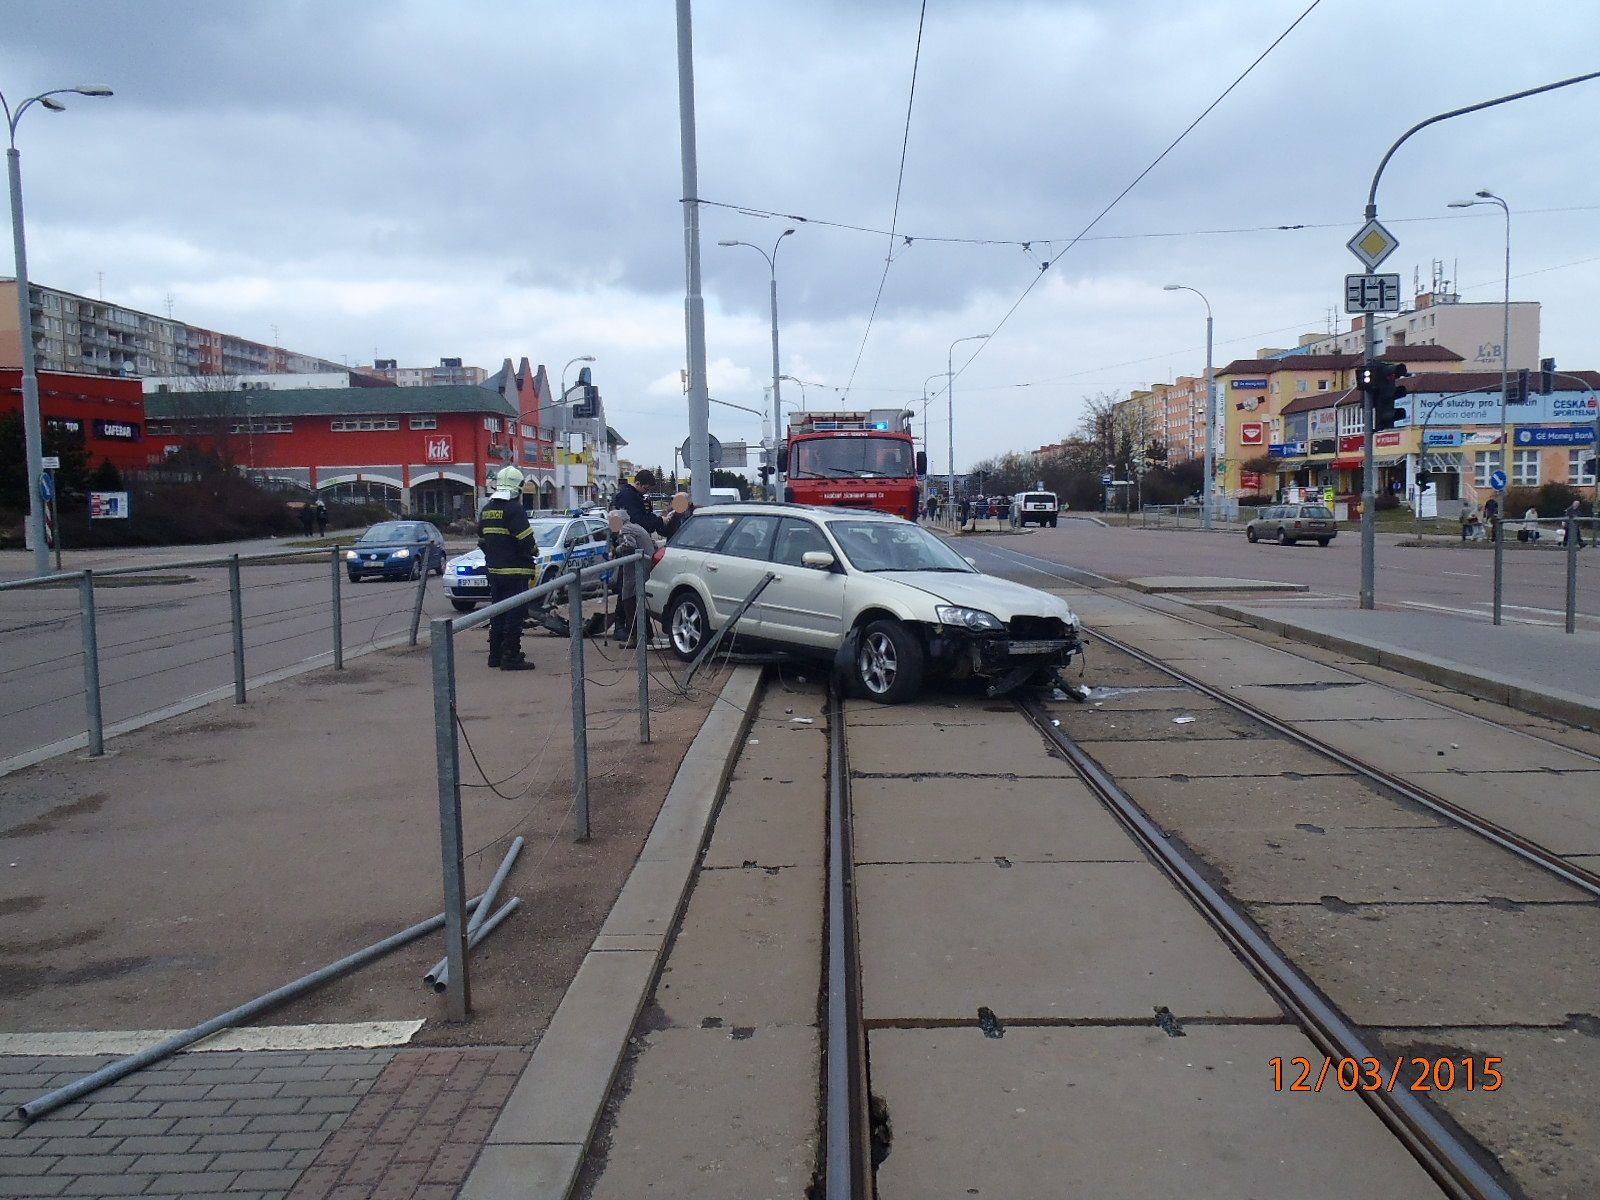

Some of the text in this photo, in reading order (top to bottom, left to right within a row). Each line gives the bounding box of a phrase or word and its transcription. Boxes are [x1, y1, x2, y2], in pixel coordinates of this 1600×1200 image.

[1446, 399, 1475, 409] služby
[1478, 400, 1494, 409] pro
[1553, 398, 1586, 409] ČESKÁ
[1548, 432, 1573, 442] Money
